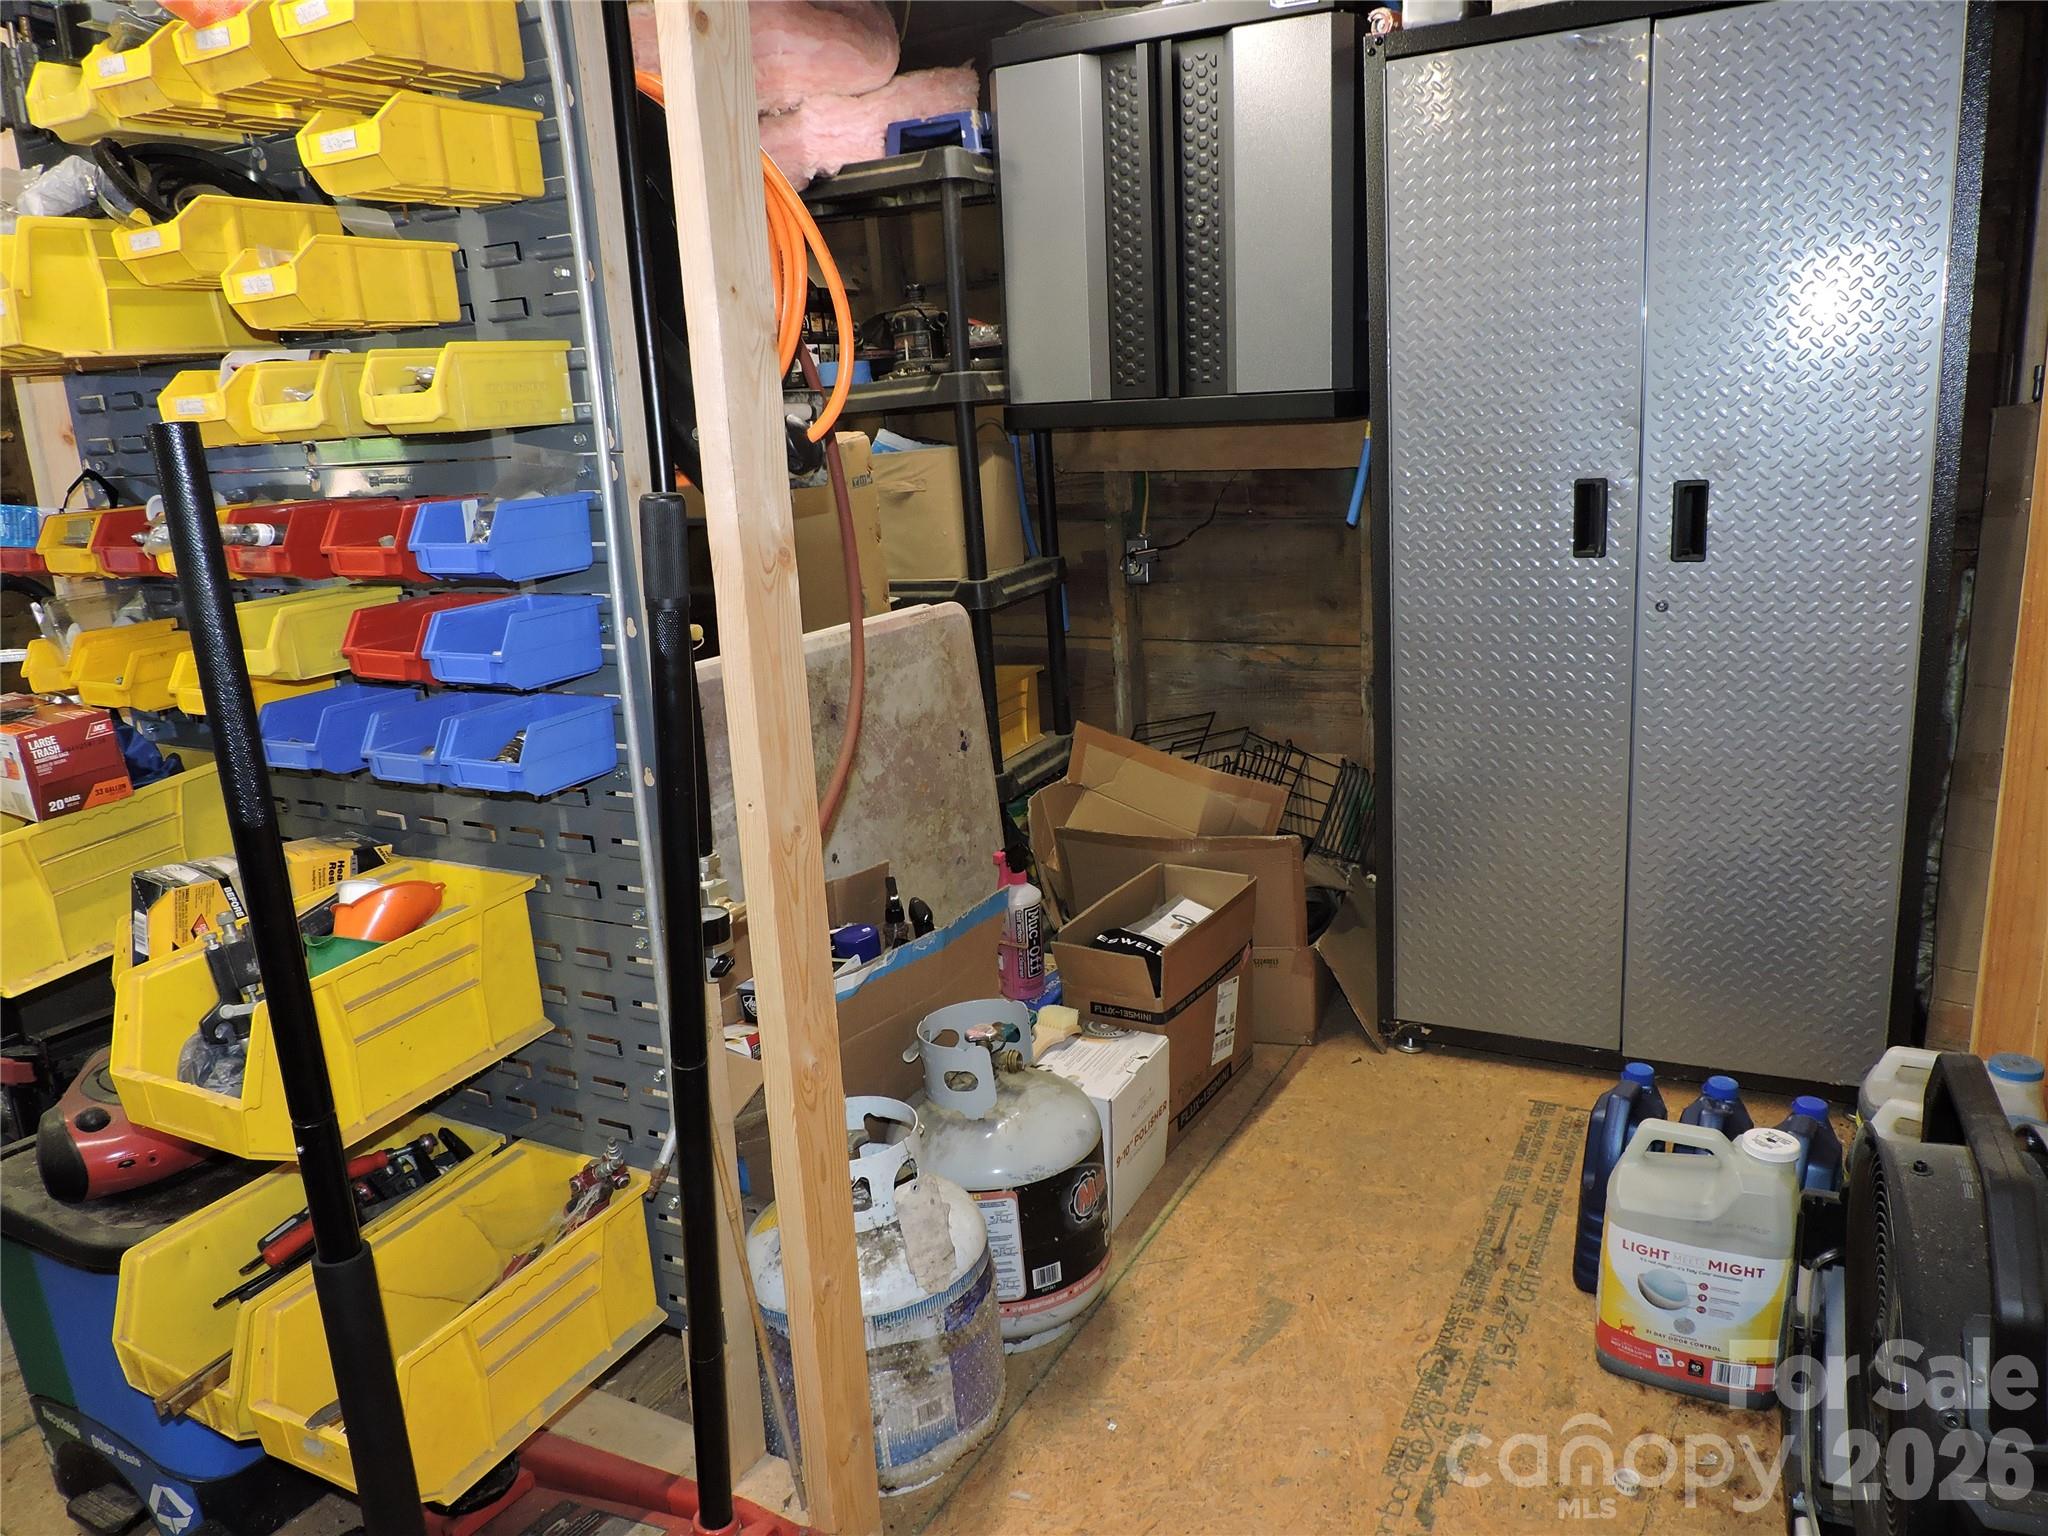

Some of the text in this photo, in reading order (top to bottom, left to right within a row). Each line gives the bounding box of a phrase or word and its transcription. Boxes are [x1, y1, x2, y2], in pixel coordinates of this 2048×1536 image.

[28, 735, 58, 751] LARGE
[31, 744, 61, 760] TRASH
[48, 799, 64, 812] 20
[223, 886, 246, 919] BEFORE
[1028, 907, 1041, 974] Muc-Off
[1133, 1099, 1168, 1148] POLISHER
[1622, 1239, 1671, 1262] LIGHT
[1708, 1259, 1766, 1279] MIGHT
[1490, 1309, 1531, 1369] 19/32
[1668, 1336, 1689, 1346] ODOR
[1690, 1341, 1721, 1353] CONTROL
